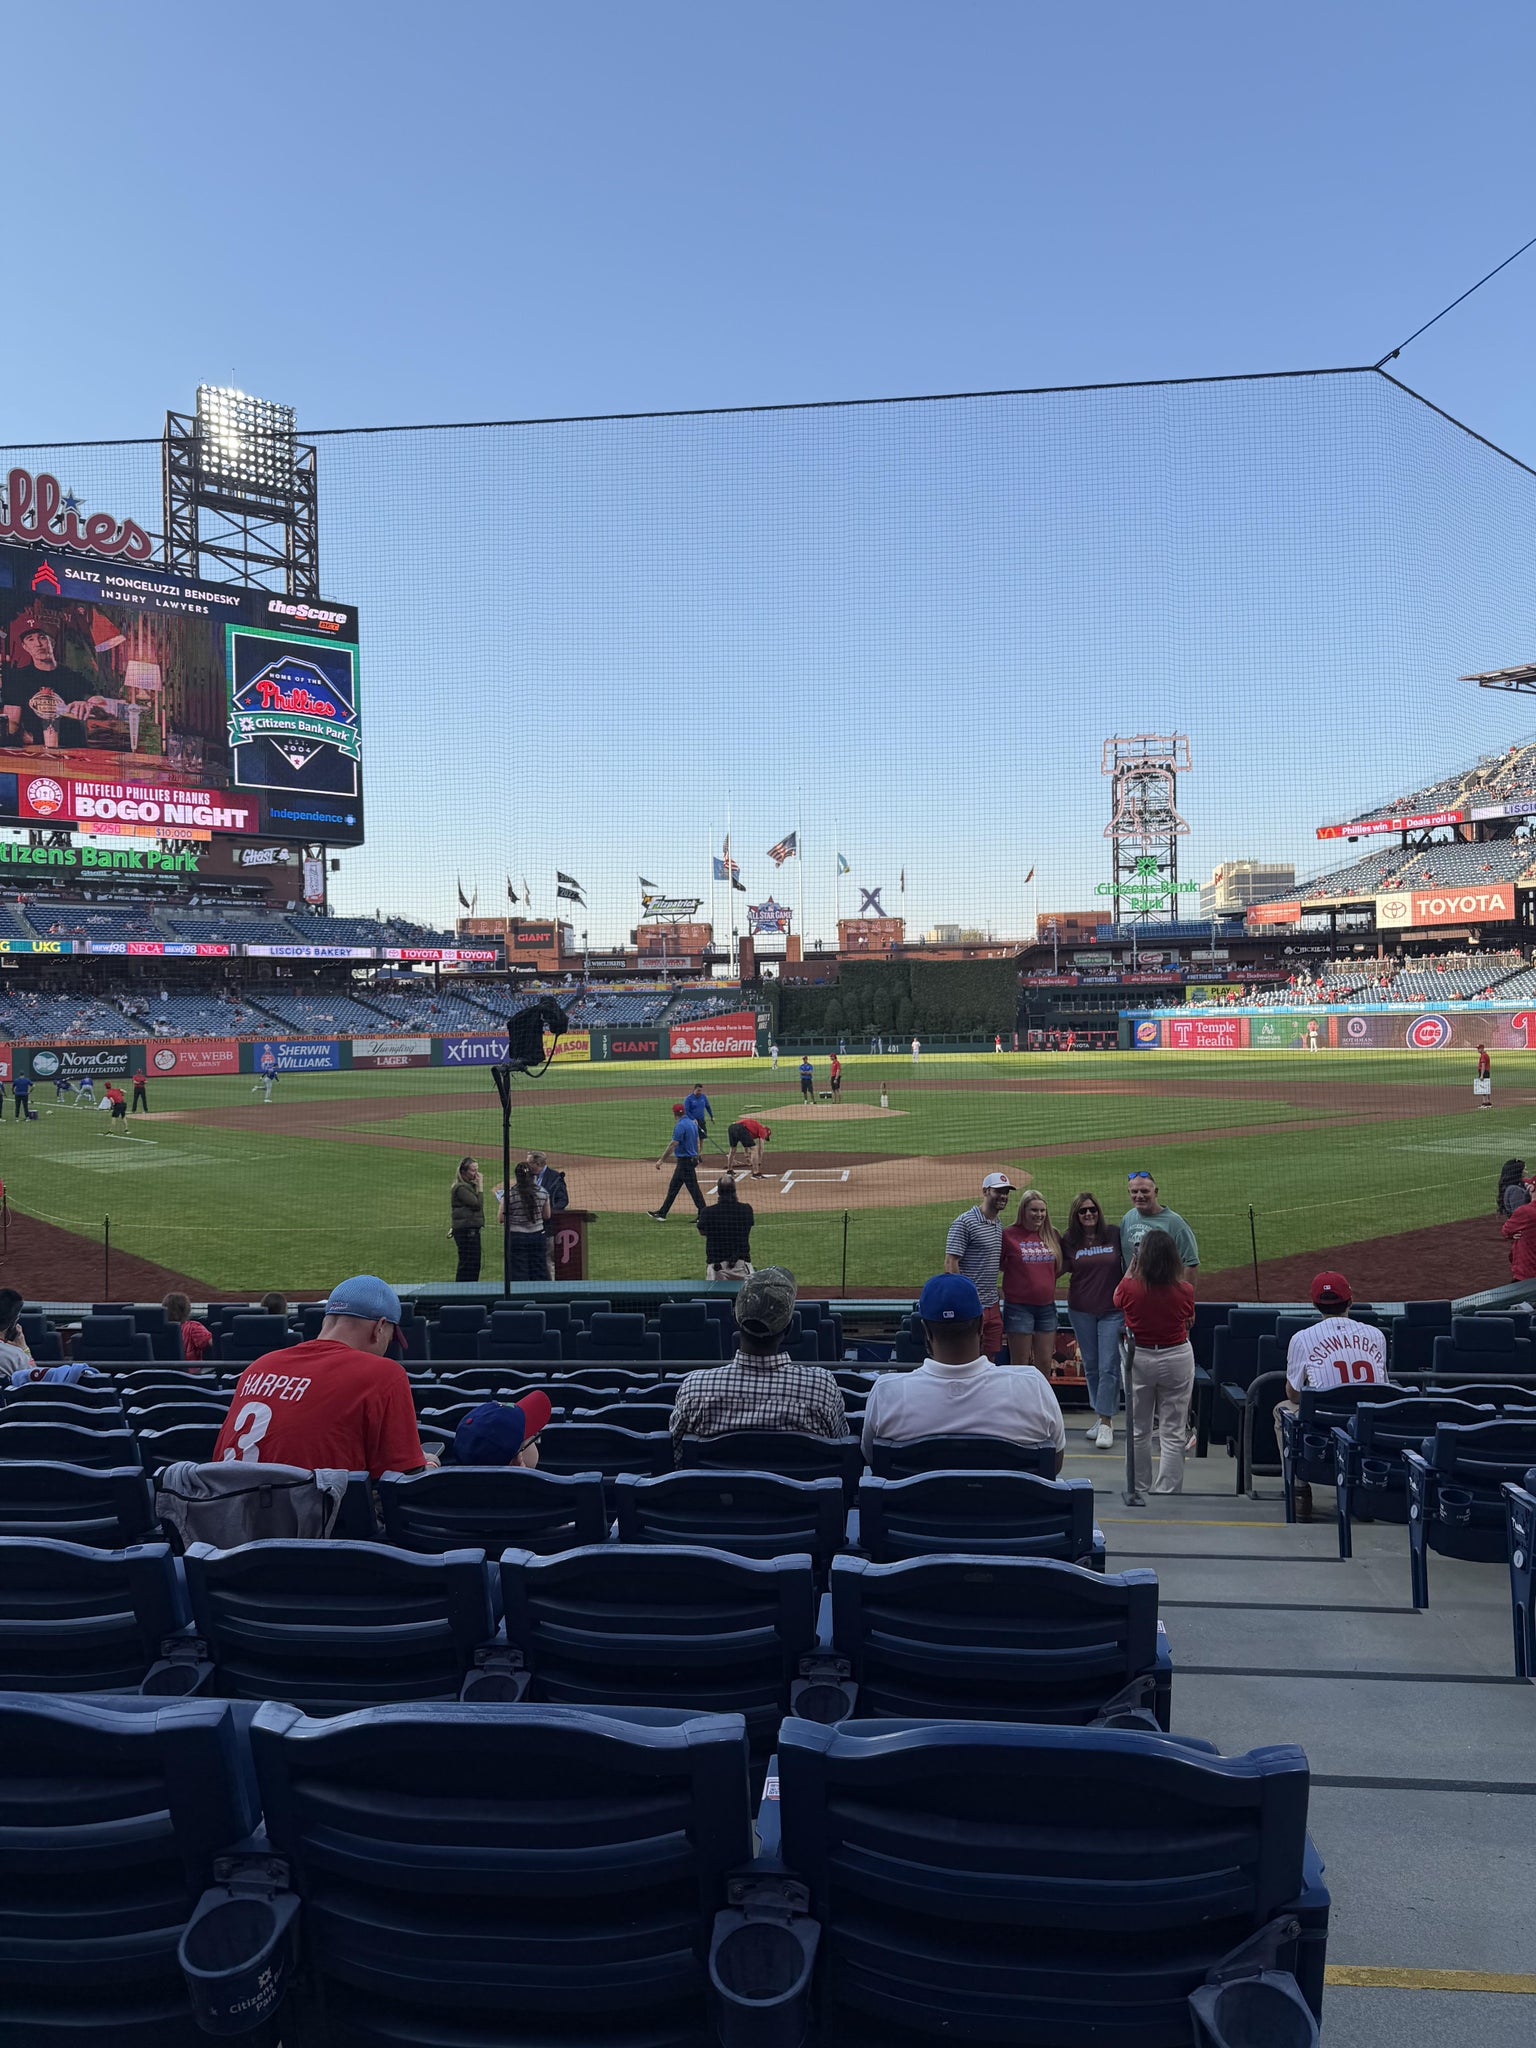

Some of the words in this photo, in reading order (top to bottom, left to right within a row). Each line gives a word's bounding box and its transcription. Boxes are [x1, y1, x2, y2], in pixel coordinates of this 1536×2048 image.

[0, 466, 152, 561] llies
[64, 568, 101, 583] SALTZ
[105, 575, 181, 596] MONGELUZZI
[184, 588, 241, 606] BENDESKY
[101, 589, 147, 604] INJURY
[155, 598, 210, 614] LAWYERS
[268, 599, 348, 624] theScore
[269, 673, 291, 681] HOME
[256, 680, 336, 717] Phillies
[255, 718, 297, 730] Citizens
[298, 721, 325, 735] Bank
[326, 726, 347, 740] Park
[283, 744, 312, 753] 2004
[75, 782, 123, 799] HATFIELD
[126, 787, 171, 802] PHILLIES
[173, 791, 211, 806] FRANKS
[75, 797, 160, 822] BOGO
[164, 804, 249, 828] NIGHT
[270, 808, 344, 824] Independence
[1504, 803, 1536, 815] LISCI
[1342, 825, 1371, 836] Phillies
[1373, 823, 1388, 831] win
[1406, 816, 1430, 827] Deals
[1431, 815, 1446, 825] roll
[1448, 814, 1457, 823] in
[81, 846, 144, 869] Bank
[147, 849, 200, 872] Park
[242, 848, 279, 866] GHOST
[1097, 882, 1157, 895] Citizens
[1160, 879, 1197, 893] Bank
[858, 887, 888, 917] X
[1131, 897, 1163, 910] Park
[1417, 894, 1506, 916] TOYOTA
[760, 911, 775, 920] STAR
[775, 910, 792, 919] GAME
[517, 933, 551, 942] GIANT
[32, 941, 60, 952] UKG
[130, 943, 160, 954] NECA
[200, 945, 229, 955] NECA
[270, 946, 311, 956] LISCIO'S
[314, 948, 352, 957] BAKERY
[404, 950, 439, 959] TOYOTA
[459, 951, 493, 960] TOYOTA
[1211, 987, 1231, 995] PLAY
[1175, 1022, 1192, 1046] T
[1195, 1022, 1236, 1034] Temple
[1196, 1035, 1234, 1047] Health
[277, 1044, 331, 1056] SHERWIN
[368, 1041, 415, 1056] Yuengling
[448, 1039, 510, 1061] xfinity
[611, 1041, 659, 1052] GIANT
[887, 1044, 899, 1053] 401
[60, 1052, 127, 1066] NovaCare
[180, 1052, 198, 1062] F.W.
[201, 1051, 234, 1060] WEBB
[376, 1056, 409, 1066] LAGER
[61, 1066, 126, 1075] REHABILITATION
[555, 1229, 579, 1264] P
[1075, 1245, 1114, 1260] phillies
[1309, 1334, 1383, 1366] SCHWARBER
[239, 1373, 312, 1402] HARPER
[223, 1401, 272, 1463] 3
[229, 1982, 274, 2014] Citizens
[255, 1989, 278, 2012] Park
